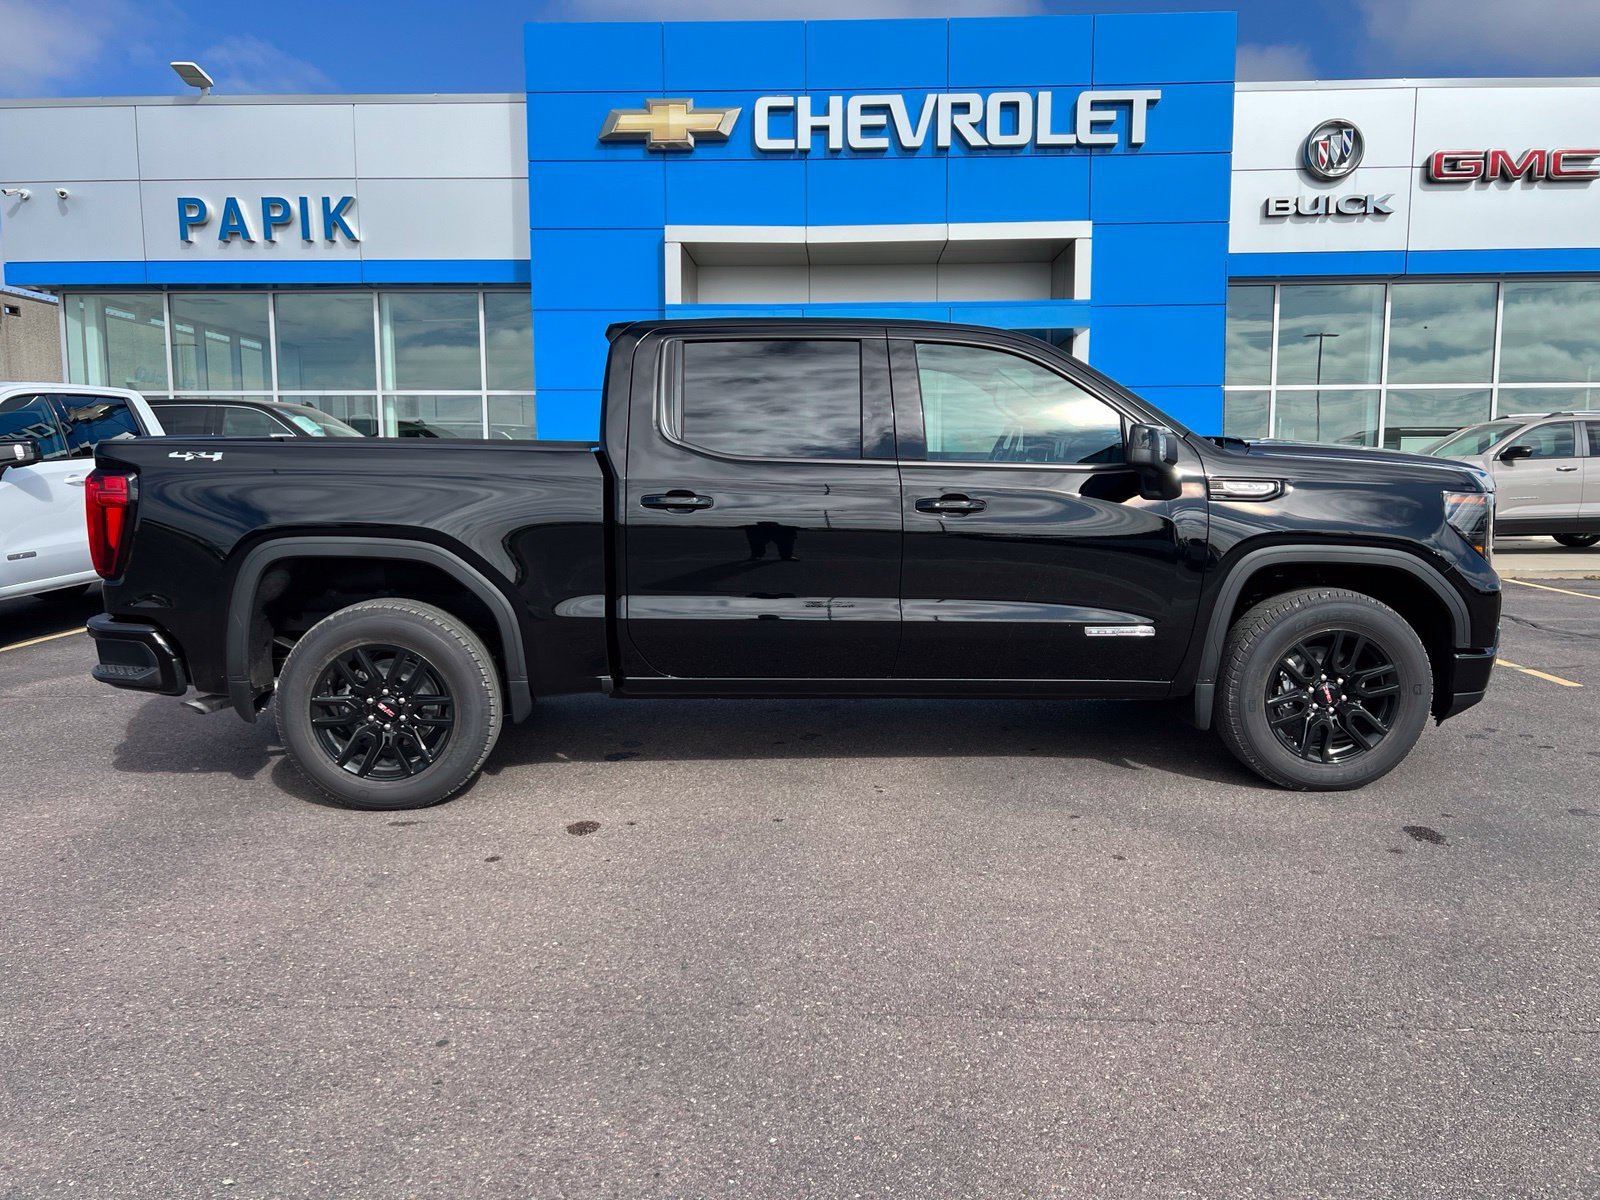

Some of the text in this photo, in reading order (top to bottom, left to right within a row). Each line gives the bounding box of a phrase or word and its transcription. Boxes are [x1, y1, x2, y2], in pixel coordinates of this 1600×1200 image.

[753, 89, 1162, 151] CHEVROLET
[1431, 149, 1600, 181] GMC
[177, 196, 360, 242] PAPIK
[1266, 193, 1395, 216] BUICK
